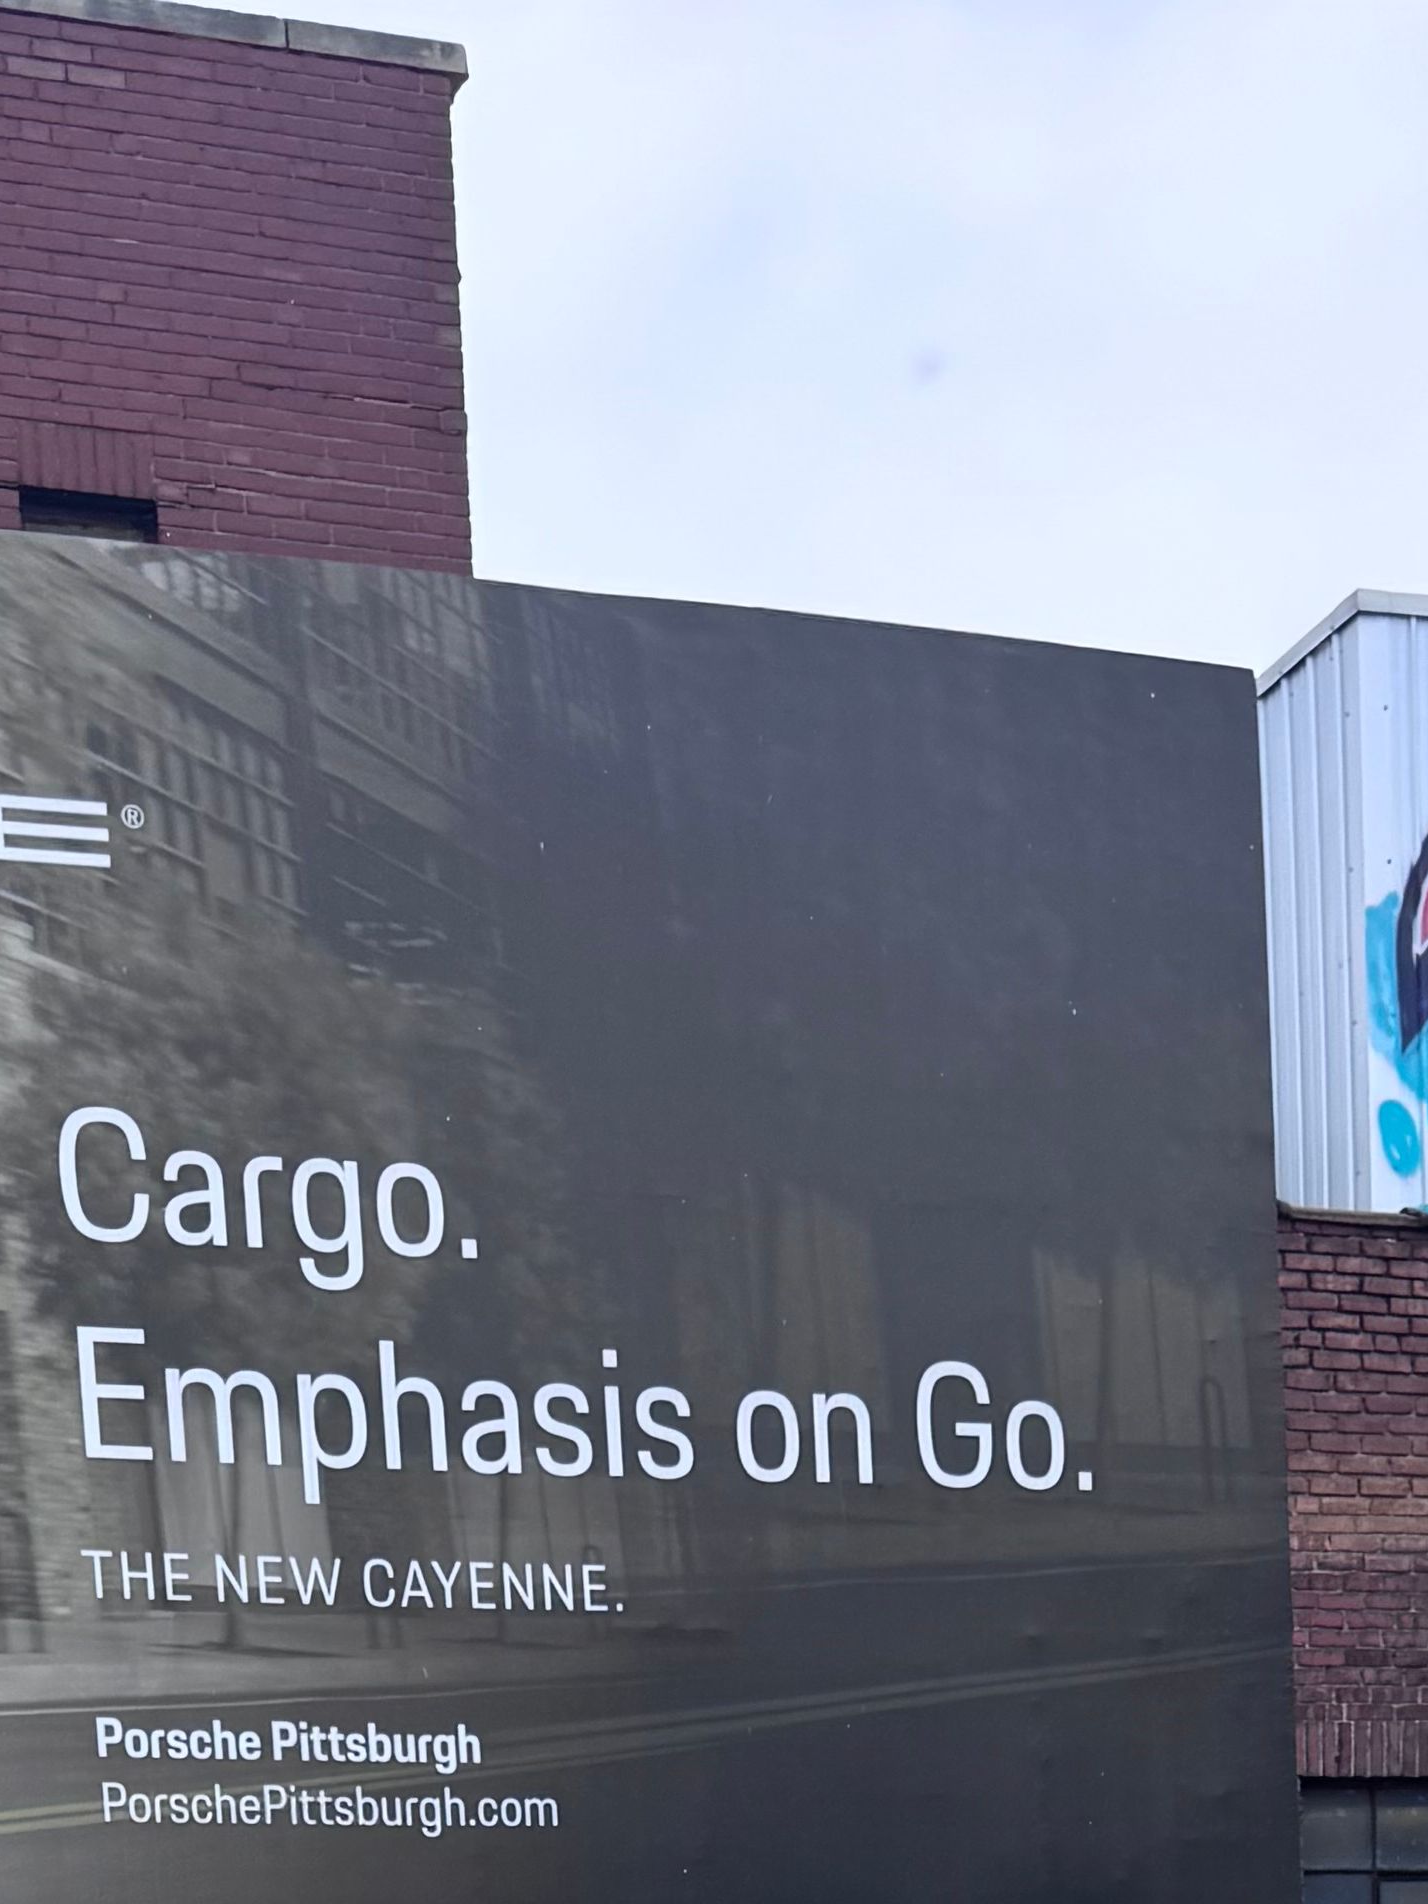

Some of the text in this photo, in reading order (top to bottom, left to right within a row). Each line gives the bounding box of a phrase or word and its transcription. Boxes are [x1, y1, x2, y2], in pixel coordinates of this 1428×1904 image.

[58, 1106, 478, 1291] Cargo.
[76, 1326, 1093, 1505] Emphasis on Go.
[80, 1548, 624, 1612] THE NEW CAYENNE.
[95, 1716, 481, 1774] Porsche Pittsburgh
[101, 1781, 558, 1838] PorschePittsburgh.com
